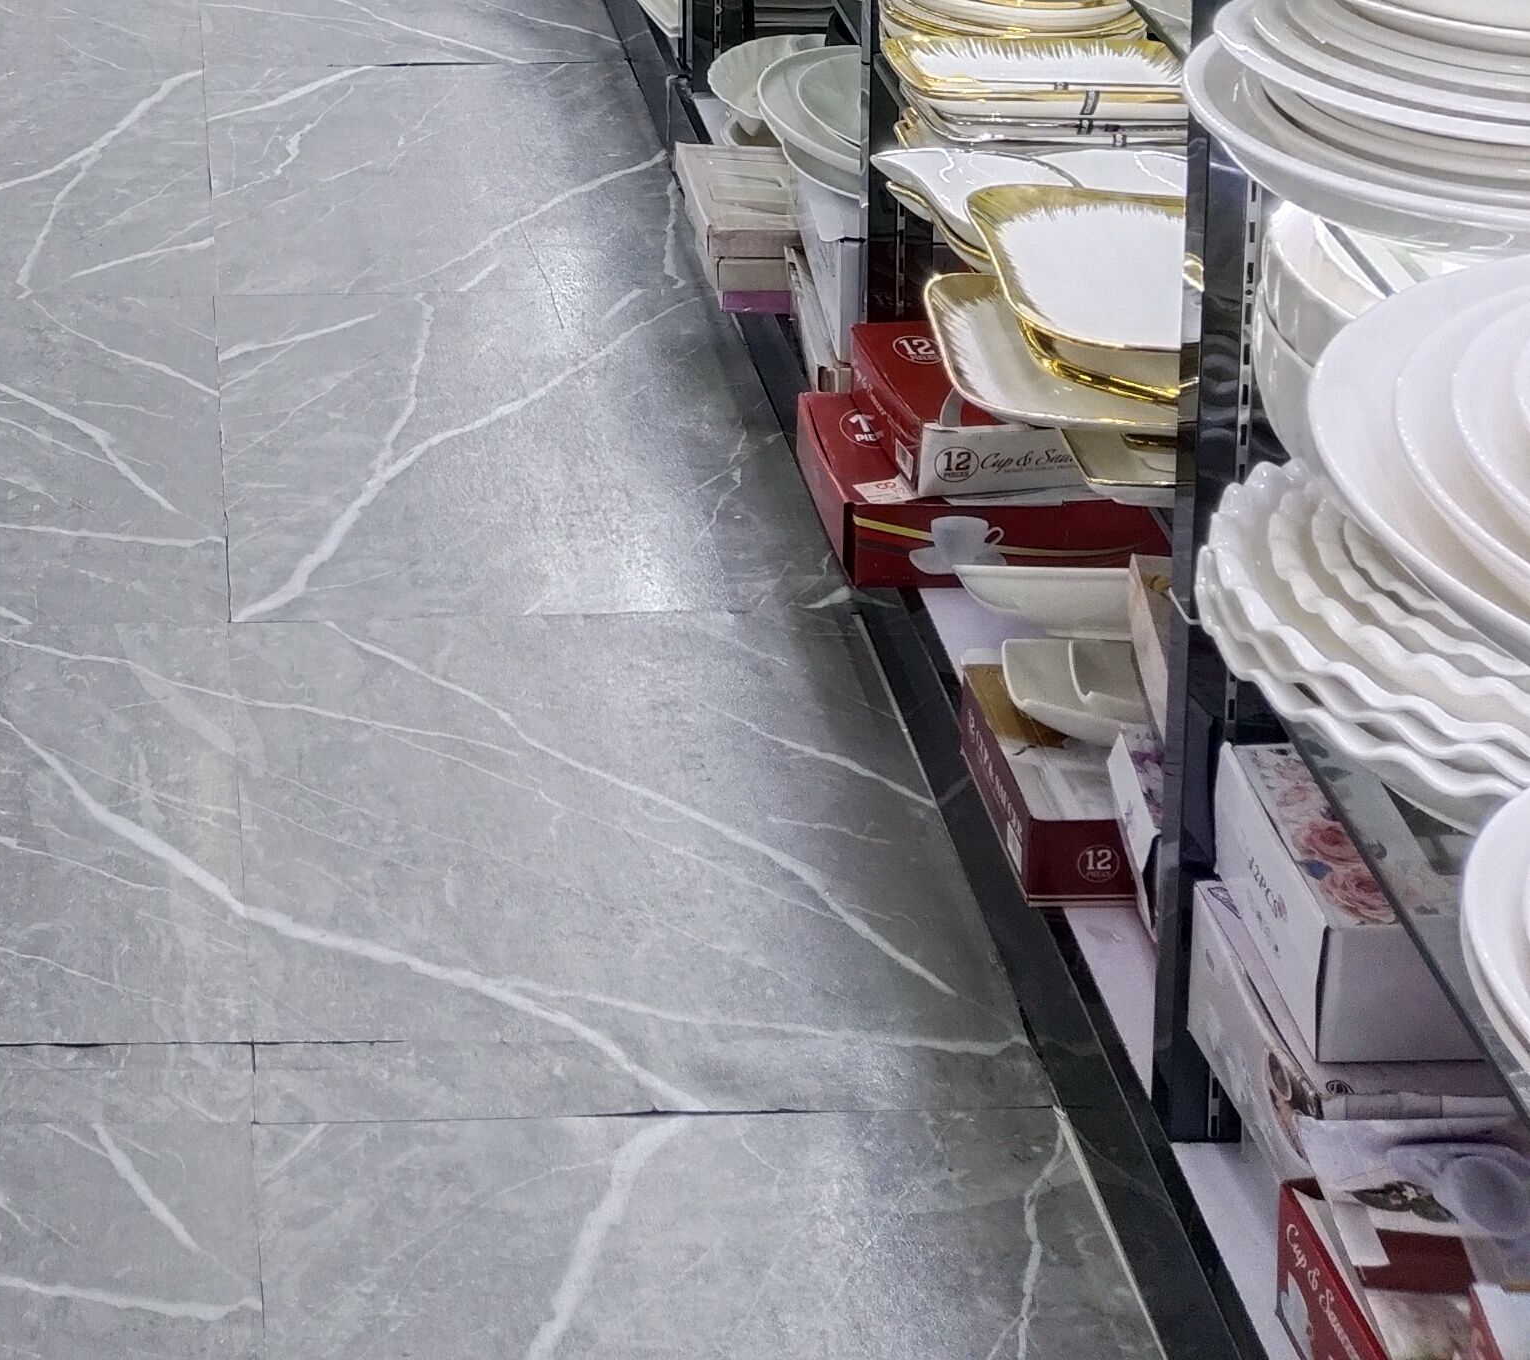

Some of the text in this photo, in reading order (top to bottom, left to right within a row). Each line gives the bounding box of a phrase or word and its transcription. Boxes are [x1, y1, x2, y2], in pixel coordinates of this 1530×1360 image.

[898, 339, 936, 355] 12
[943, 450, 972, 472] 12
[980, 452, 1013, 475] Cup
[1016, 450, 1035, 467] &
[1085, 849, 1112, 870] 12
[1286, 1223, 1308, 1269] Cup
[1307, 1267, 1321, 1291] &
